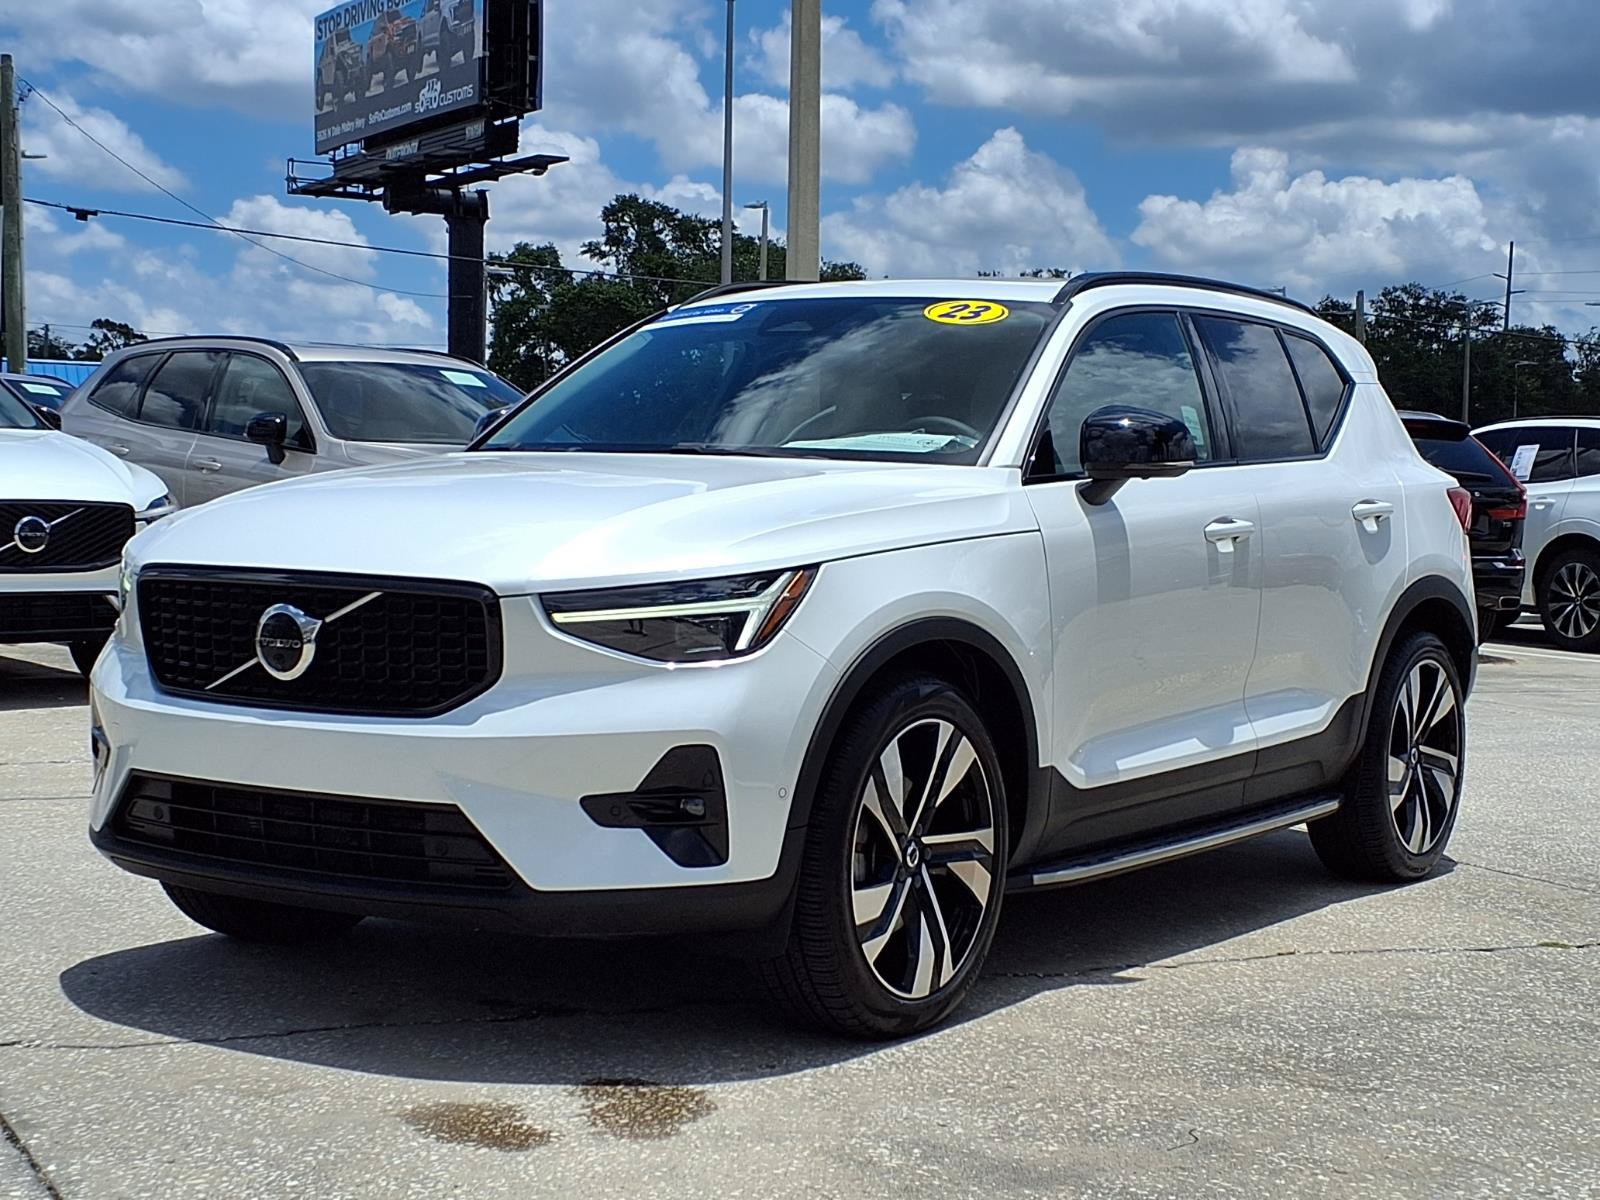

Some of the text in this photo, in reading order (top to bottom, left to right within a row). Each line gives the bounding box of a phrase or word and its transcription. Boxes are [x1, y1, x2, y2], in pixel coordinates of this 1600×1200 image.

[317, 0, 384, 40] STOP DRIVING
[439, 84, 474, 106] CUSTOMS
[938, 303, 992, 320] 23
[261, 637, 301, 649] VOLVO
